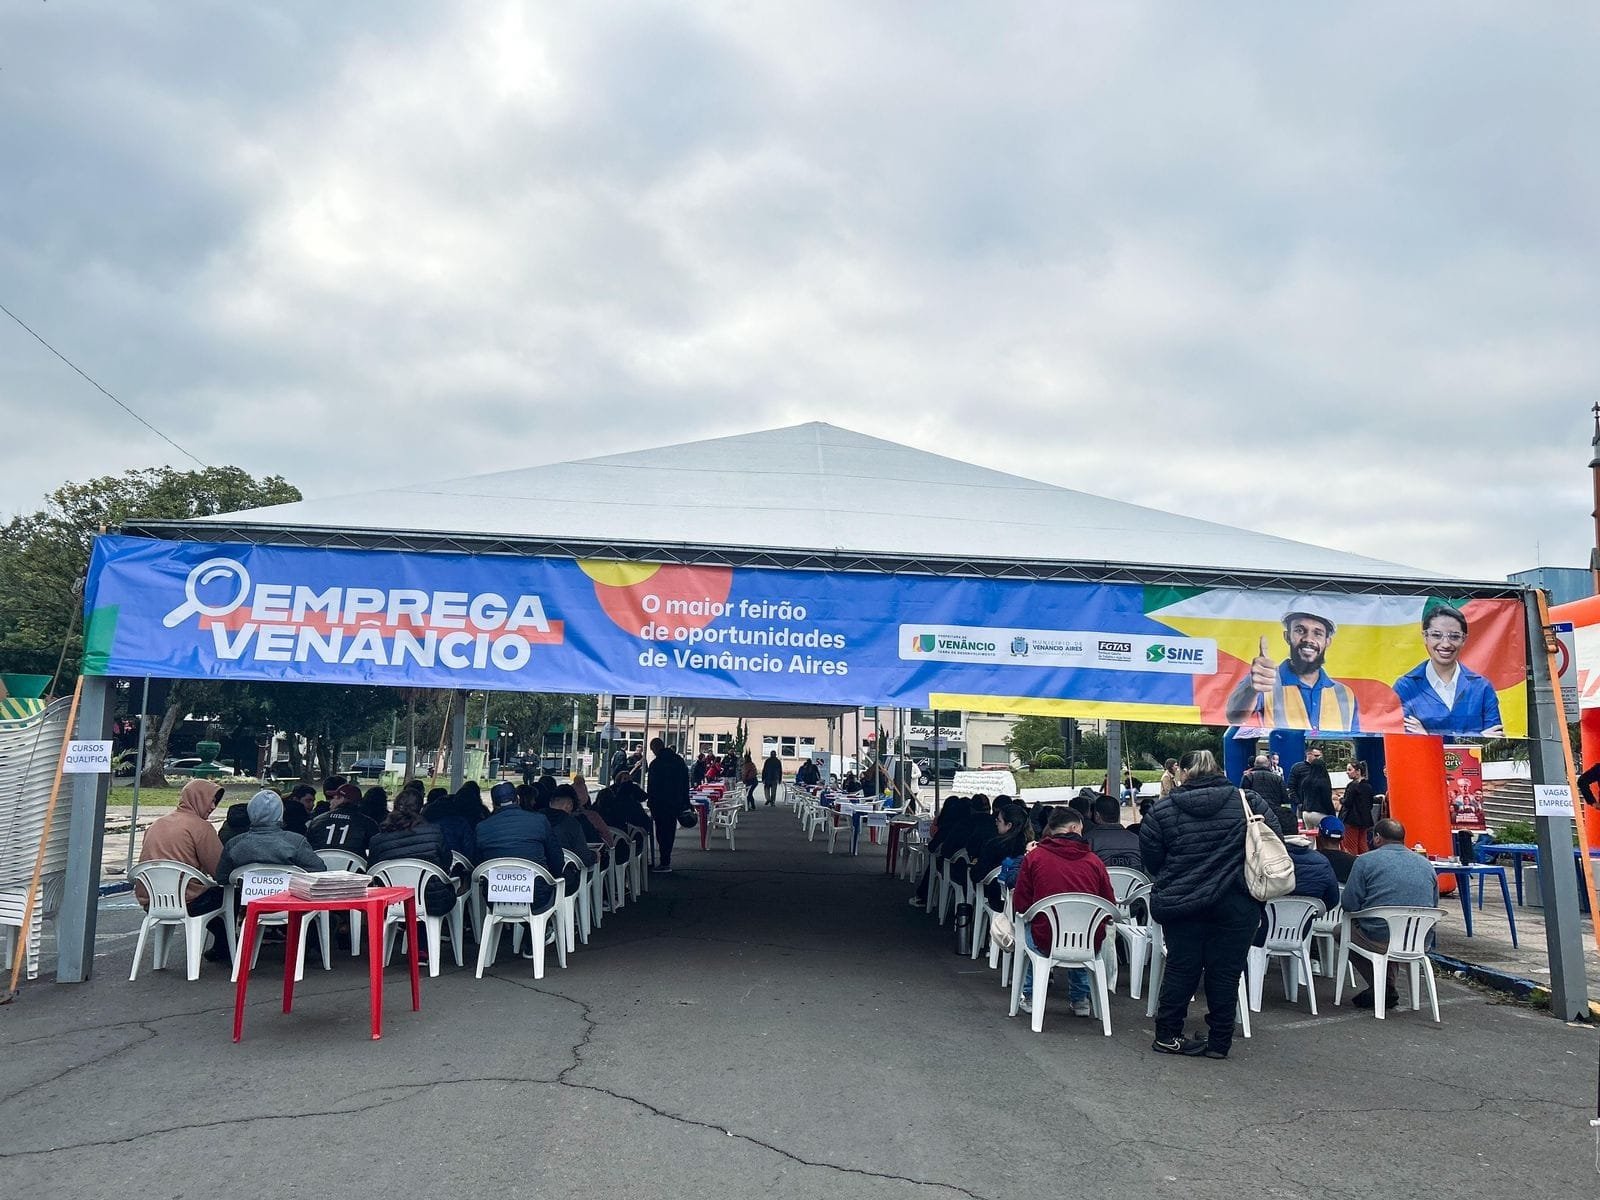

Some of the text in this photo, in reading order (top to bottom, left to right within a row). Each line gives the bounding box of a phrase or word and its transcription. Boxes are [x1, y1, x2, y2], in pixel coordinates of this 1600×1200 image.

[251, 583, 550, 633] EMPREGA
[641, 594, 807, 621] O maior feirão
[640, 622, 846, 649] de oportunidades
[211, 619, 531, 671] VENÂNCIO
[938, 639, 996, 651] VENÂNCIO
[1100, 641, 1130, 652] FGTAS
[638, 649, 848, 676] de Venâncio Aires
[72, 744, 104, 752] CURSOS
[66, 755, 108, 764] QUALIFICA
[326, 823, 349, 845] 11
[251, 876, 284, 885] CURSOS
[496, 873, 527, 881] CURSOS
[245, 887, 286, 896] QUALIFIC
[491, 884, 531, 893] QUALIFICA
